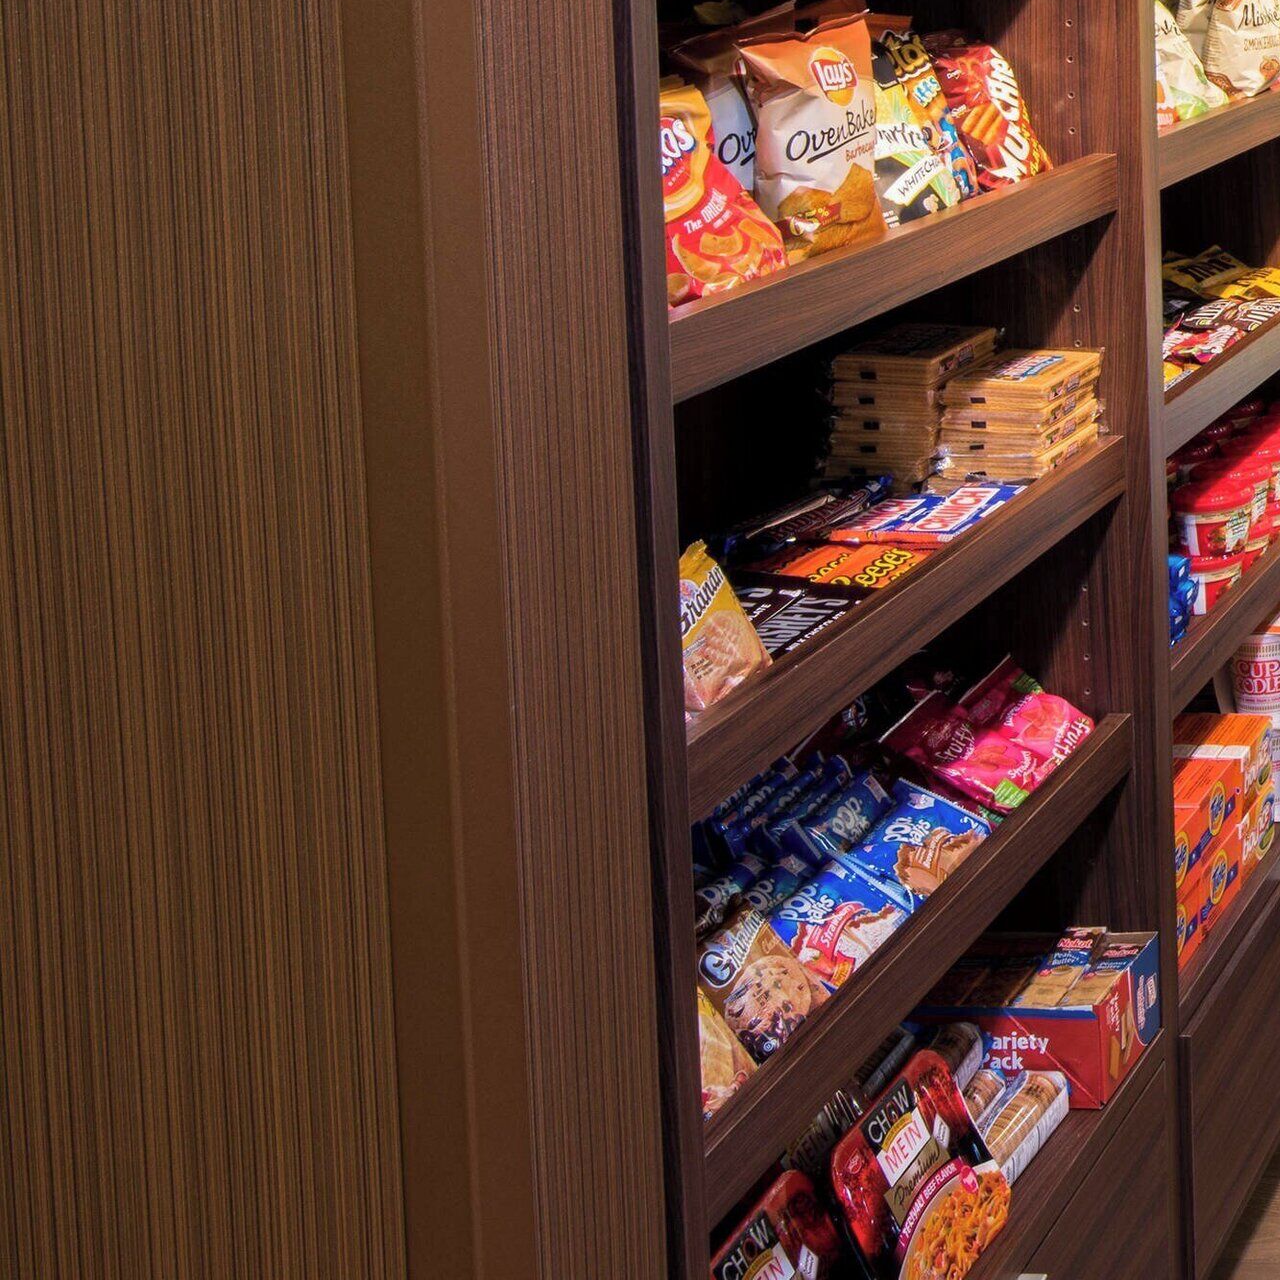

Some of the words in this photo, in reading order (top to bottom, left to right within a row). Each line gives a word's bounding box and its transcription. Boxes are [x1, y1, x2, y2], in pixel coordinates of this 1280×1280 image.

[813, 58, 855, 92] Lay's
[845, 99, 877, 137] Bake
[1236, 660, 1280, 679] CUP
[990, 1031, 1050, 1053] ariety
[867, 1085, 911, 1144] CHOW
[885, 1118, 924, 1173] MEIN
[934, 1162, 958, 1187] FLAVOR
